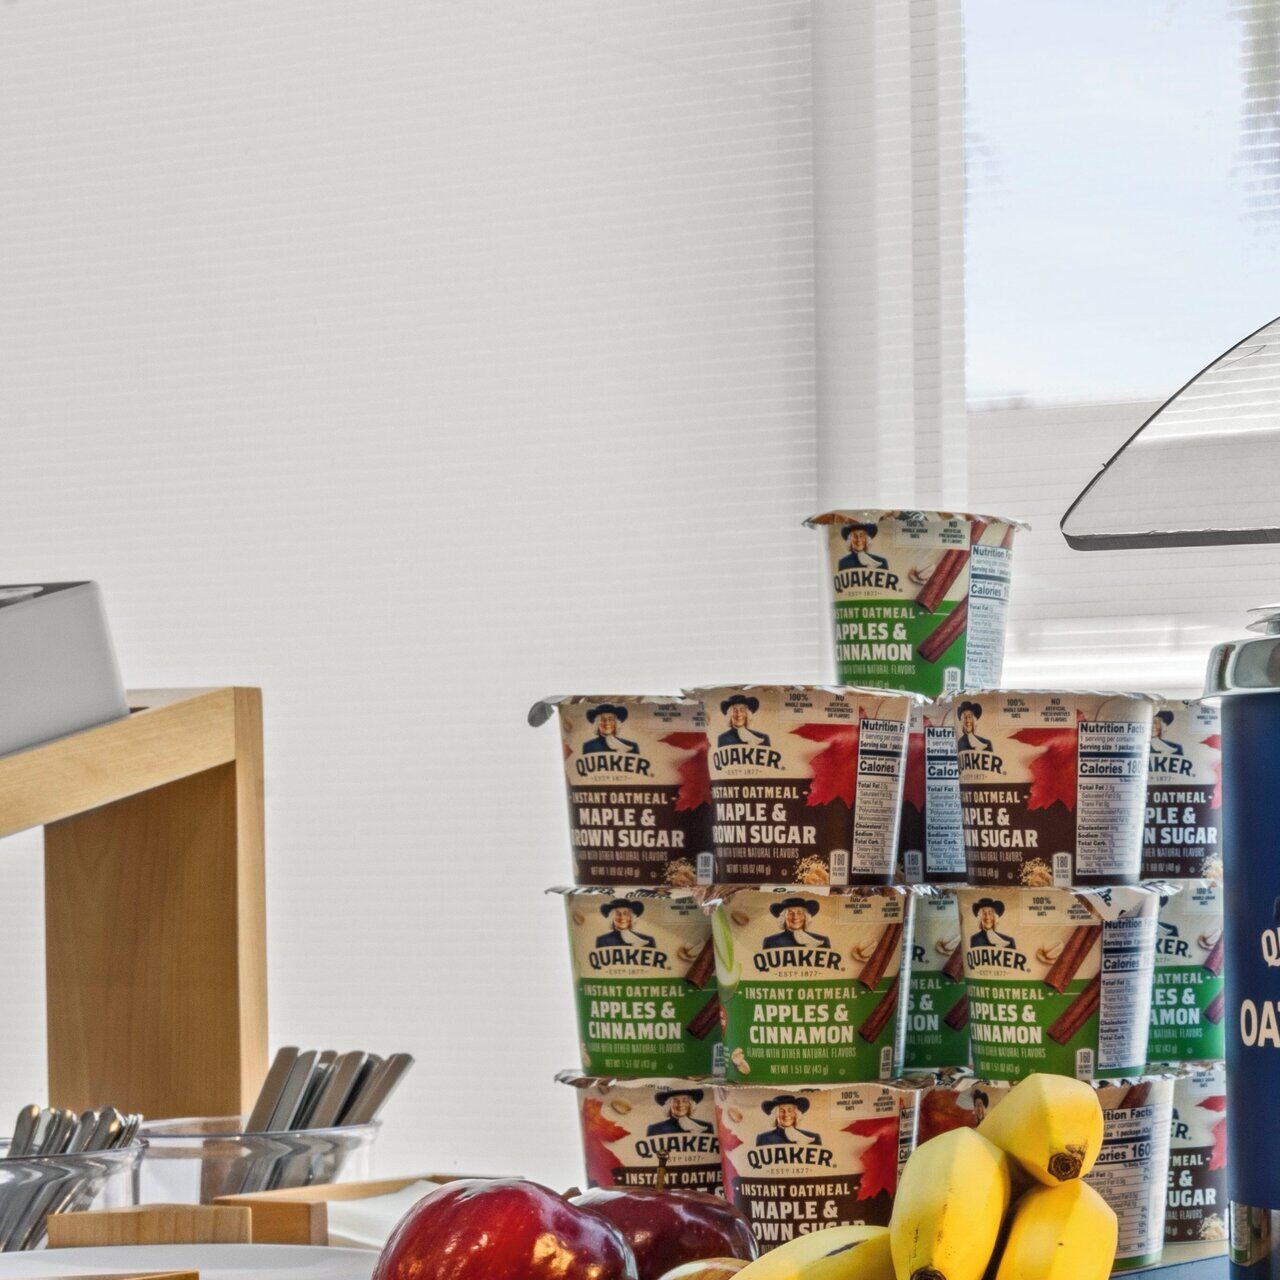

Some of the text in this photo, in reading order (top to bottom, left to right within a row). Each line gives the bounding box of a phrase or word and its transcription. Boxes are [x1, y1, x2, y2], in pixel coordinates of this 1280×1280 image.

[972, 546, 1004, 559] Nutrition
[834, 570, 899, 593] QUAKER
[971, 583, 1001, 597] Calories
[862, 607, 916, 619] OATMEAL
[836, 622, 907, 641] APPLES &
[836, 643, 913, 661] CINNAMON
[1007, 698, 1025, 706] 100%
[861, 720, 898, 732] Nutrition
[927, 728, 954, 738] Nutri
[1080, 722, 1145, 734] Nutrition Facts
[576, 755, 650, 777] QUAKER
[713, 747, 782, 771] QUAKER
[860, 760, 895, 773] Calories
[958, 752, 1003, 775] UAKER
[1149, 756, 1193, 777] KER
[928, 765, 959, 777] Calor
[1080, 762, 1123, 774] Calories
[610, 792, 668, 805] OATMEAL
[742, 786, 799, 799] OATMEAL
[974, 791, 1020, 803] OATMEAL
[1153, 791, 1207, 803] OATMEAL
[579, 808, 656, 827] MAPLE &
[716, 803, 787, 822] MAPLE &
[997, 807, 1010, 826] &
[1144, 806, 1178, 824] PLE
[1182, 806, 1196, 824] &
[618, 830, 685, 848] SUGAR
[750, 825, 817, 844] SUGAR
[981, 829, 1038, 848] SUGAR
[1160, 827, 1218, 844] SUGAR
[773, 848, 799, 858] FLAVORS
[1032, 896, 1051, 905] 100%
[1104, 919, 1142, 930] Nutrition
[589, 948, 668, 970] QUAKER
[753, 949, 842, 972] QUAKER
[967, 949, 1027, 972] QUAKER
[1103, 959, 1140, 970] Calories
[584, 985, 685, 997] INSTANT OATMEAL
[910, 979, 942, 990] MEAL
[745, 987, 857, 1000] INSTANT OATMEAL
[992, 987, 1044, 1000] OATMEAL
[1181, 987, 1196, 1005] &
[591, 1000, 676, 1019] APPLES &
[919, 994, 933, 1011] &
[753, 1004, 849, 1022] APPLES &
[970, 1001, 1036, 1022] APPLES &
[1151, 1007, 1200, 1026] AMON
[588, 1021, 682, 1040] CINNAMON
[750, 1025, 854, 1044] CINNAMON
[971, 1023, 1042, 1044] CINNAMON
[660, 1043, 685, 1054] FLAVORS
[766, 1047, 781, 1058] WITH
[781, 1047, 800, 1059] OTHER
[802, 1047, 829, 1059] NATURAL
[831, 1047, 857, 1058] FLAVORS
[1021, 1047, 1047, 1059] FLAVORS
[841, 1091, 860, 1099] 100%
[1103, 1107, 1152, 1120] ition Facts
[635, 1135, 720, 1159] QUAKER
[1099, 1142, 1151, 1162] ories 160
[747, 1147, 833, 1169] QUAKER
[1168, 1154, 1204, 1167] MEAL
[681, 1170, 723, 1184] OATME
[1179, 1169, 1193, 1187] &
[741, 1183, 851, 1198] INSTANT OATMEAL
[1166, 1188, 1217, 1208] UGAR
[751, 1200, 838, 1220] MAPLE &
[752, 1221, 793, 1241] OWN
